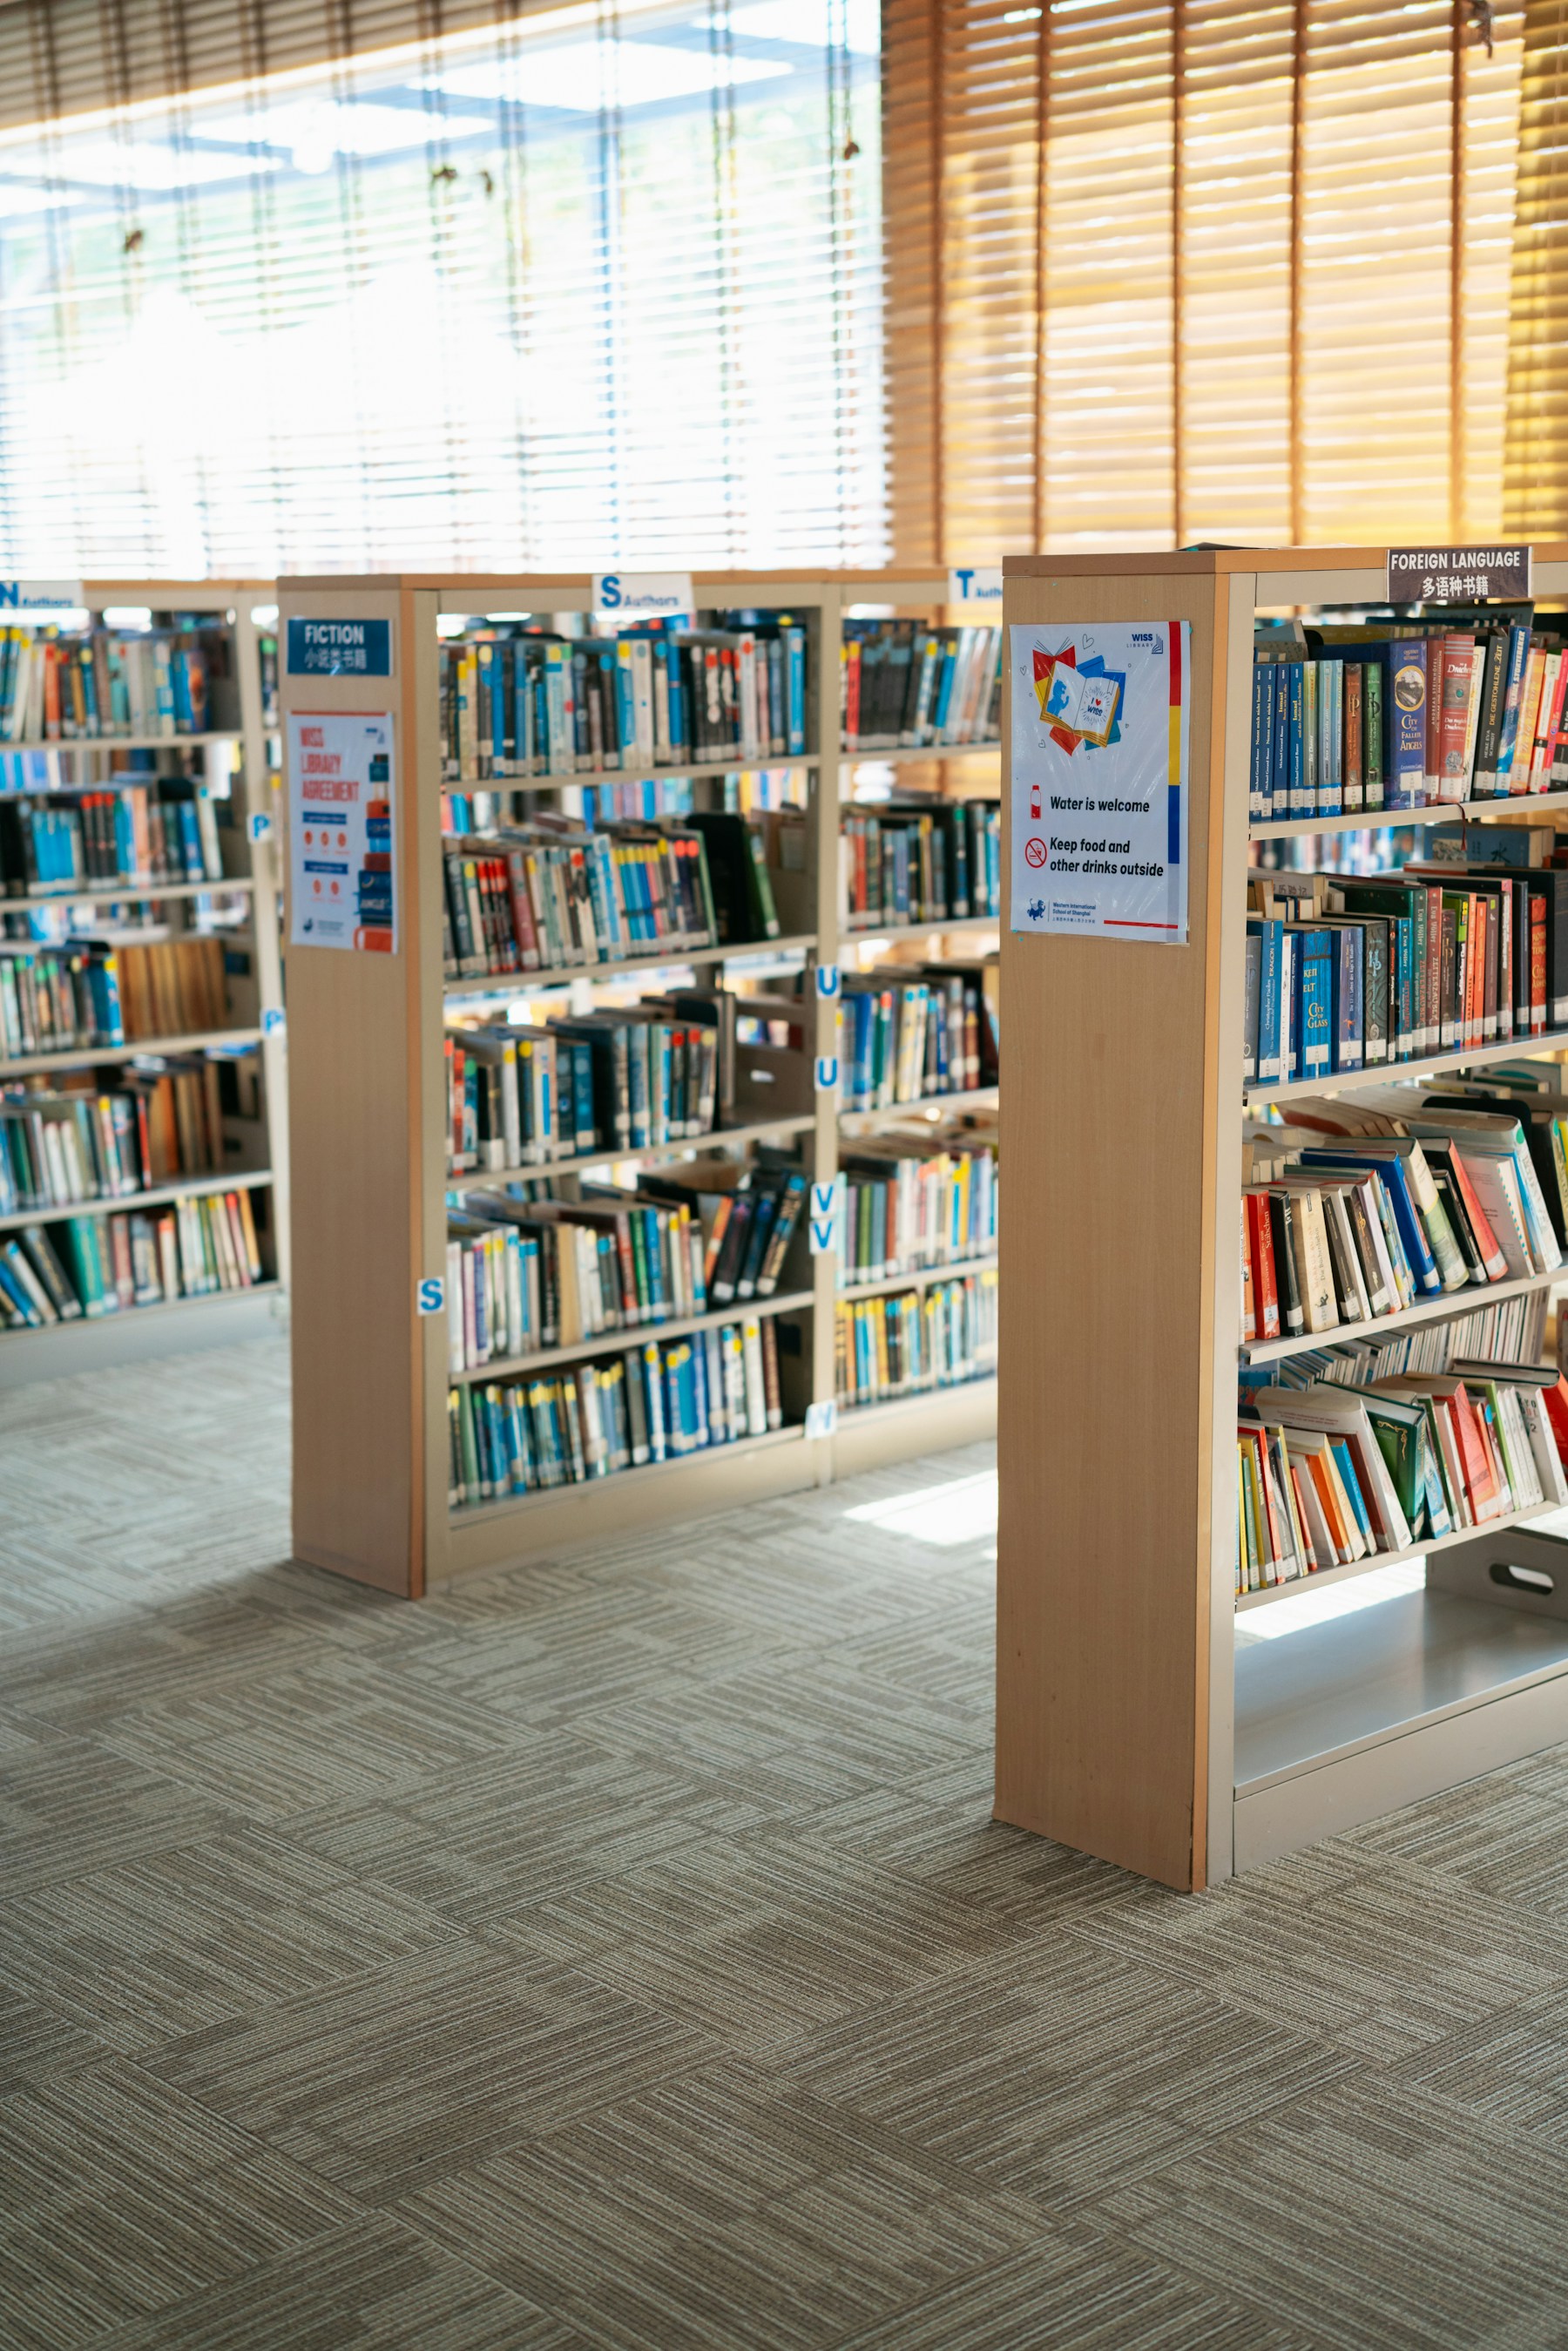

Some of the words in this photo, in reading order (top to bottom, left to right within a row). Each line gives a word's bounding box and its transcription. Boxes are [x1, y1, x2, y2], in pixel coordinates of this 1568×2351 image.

[1391, 552, 1448, 571] FOREIGN
[1452, 551, 1520, 569] LANGUAGE
[601, 575, 621, 608] S
[625, 595, 679, 607] Authors
[956, 571, 974, 599] T
[976, 587, 1003, 599] Auth
[1423, 575, 1489, 599] 多语种书籍
[305, 625, 364, 645] FICTION
[1493, 645, 1503, 664] ZEIT
[1490, 666, 1501, 713] GESTOHLENE
[1087, 705, 1103, 716] WISS
[1050, 796, 1083, 811] Water
[1085, 797, 1095, 811] is
[1098, 798, 1150, 813] welcome
[253, 815, 270, 837] P
[1050, 837, 1078, 853] Keep
[1080, 837, 1105, 853] food
[1108, 839, 1131, 854] and
[1050, 859, 1080, 873] other
[1082, 859, 1118, 875] drinks
[1120, 862, 1164, 877] outside
[819, 967, 836, 995] U
[1308, 1017, 1328, 1029] GLASS
[820, 1059, 837, 1087] U
[816, 1186, 833, 1212] V
[814, 1222, 832, 1248] V
[1263, 1210, 1272, 1249] Stäbchen
[421, 1279, 443, 1311] S
